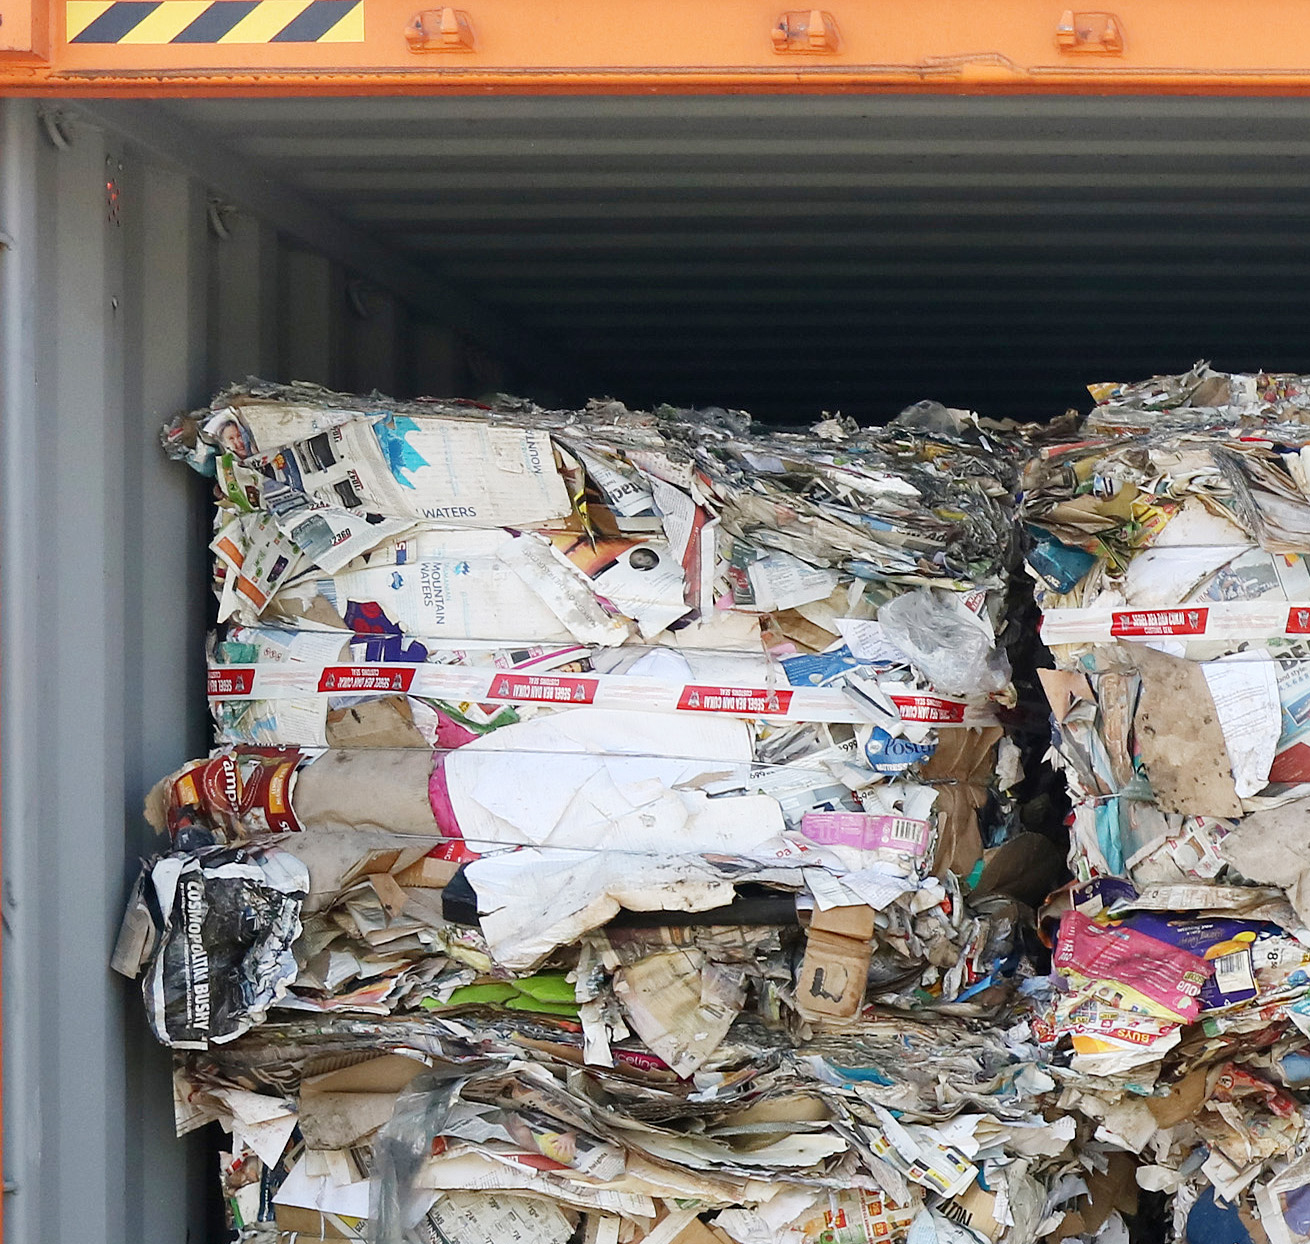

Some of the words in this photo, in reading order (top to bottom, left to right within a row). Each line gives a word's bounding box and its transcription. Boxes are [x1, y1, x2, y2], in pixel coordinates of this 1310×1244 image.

[423, 506, 477, 518] WATERS
[421, 562, 432, 606] WATERS
[432, 562, 445, 624] MOUNTAIN
[513, 684, 529, 697] CUKAI
[530, 685, 542, 698] DAN
[543, 686, 555, 699] BEA
[556, 686, 571, 700] SEGEL
[704, 696, 721, 708] CUKAI
[722, 696, 735, 709] DAN
[736, 697, 747, 710] BEA
[748, 697, 765, 711] SEGEL
[192, 984, 210, 1029] BUSHY
[1117, 1028, 1150, 1044] BUYS
